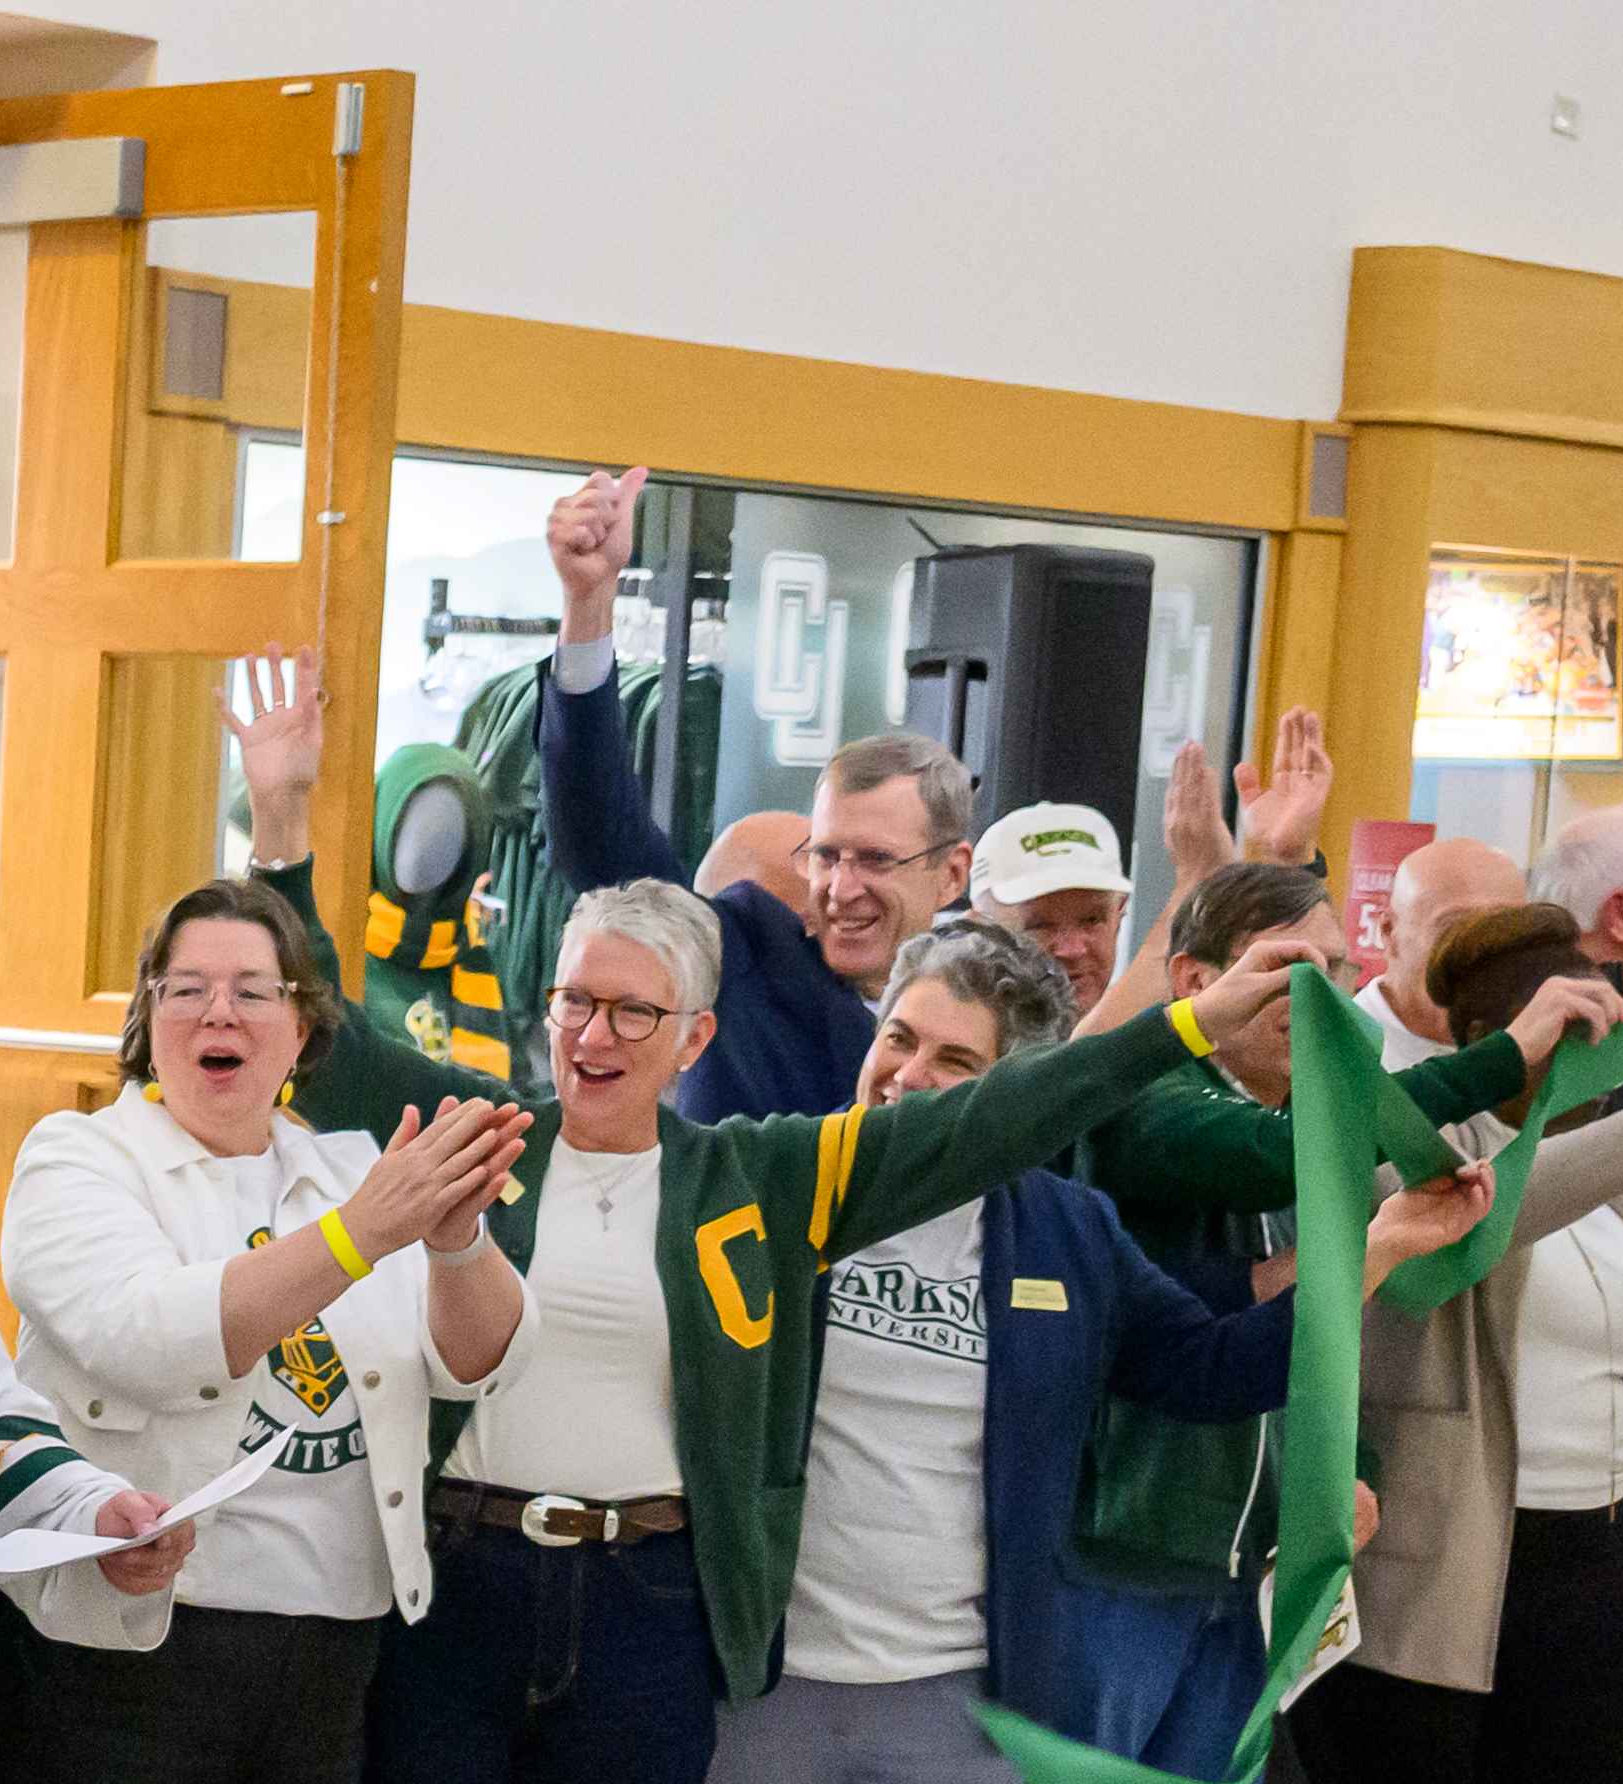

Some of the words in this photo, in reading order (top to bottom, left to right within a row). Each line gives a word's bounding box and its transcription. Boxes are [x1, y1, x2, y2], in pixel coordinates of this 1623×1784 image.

[695, 1203, 775, 1349] C
[837, 1264, 986, 1331] ARKS
[828, 1302, 983, 1355] NIVERSIT
[241, 1403, 340, 1470] WITE
